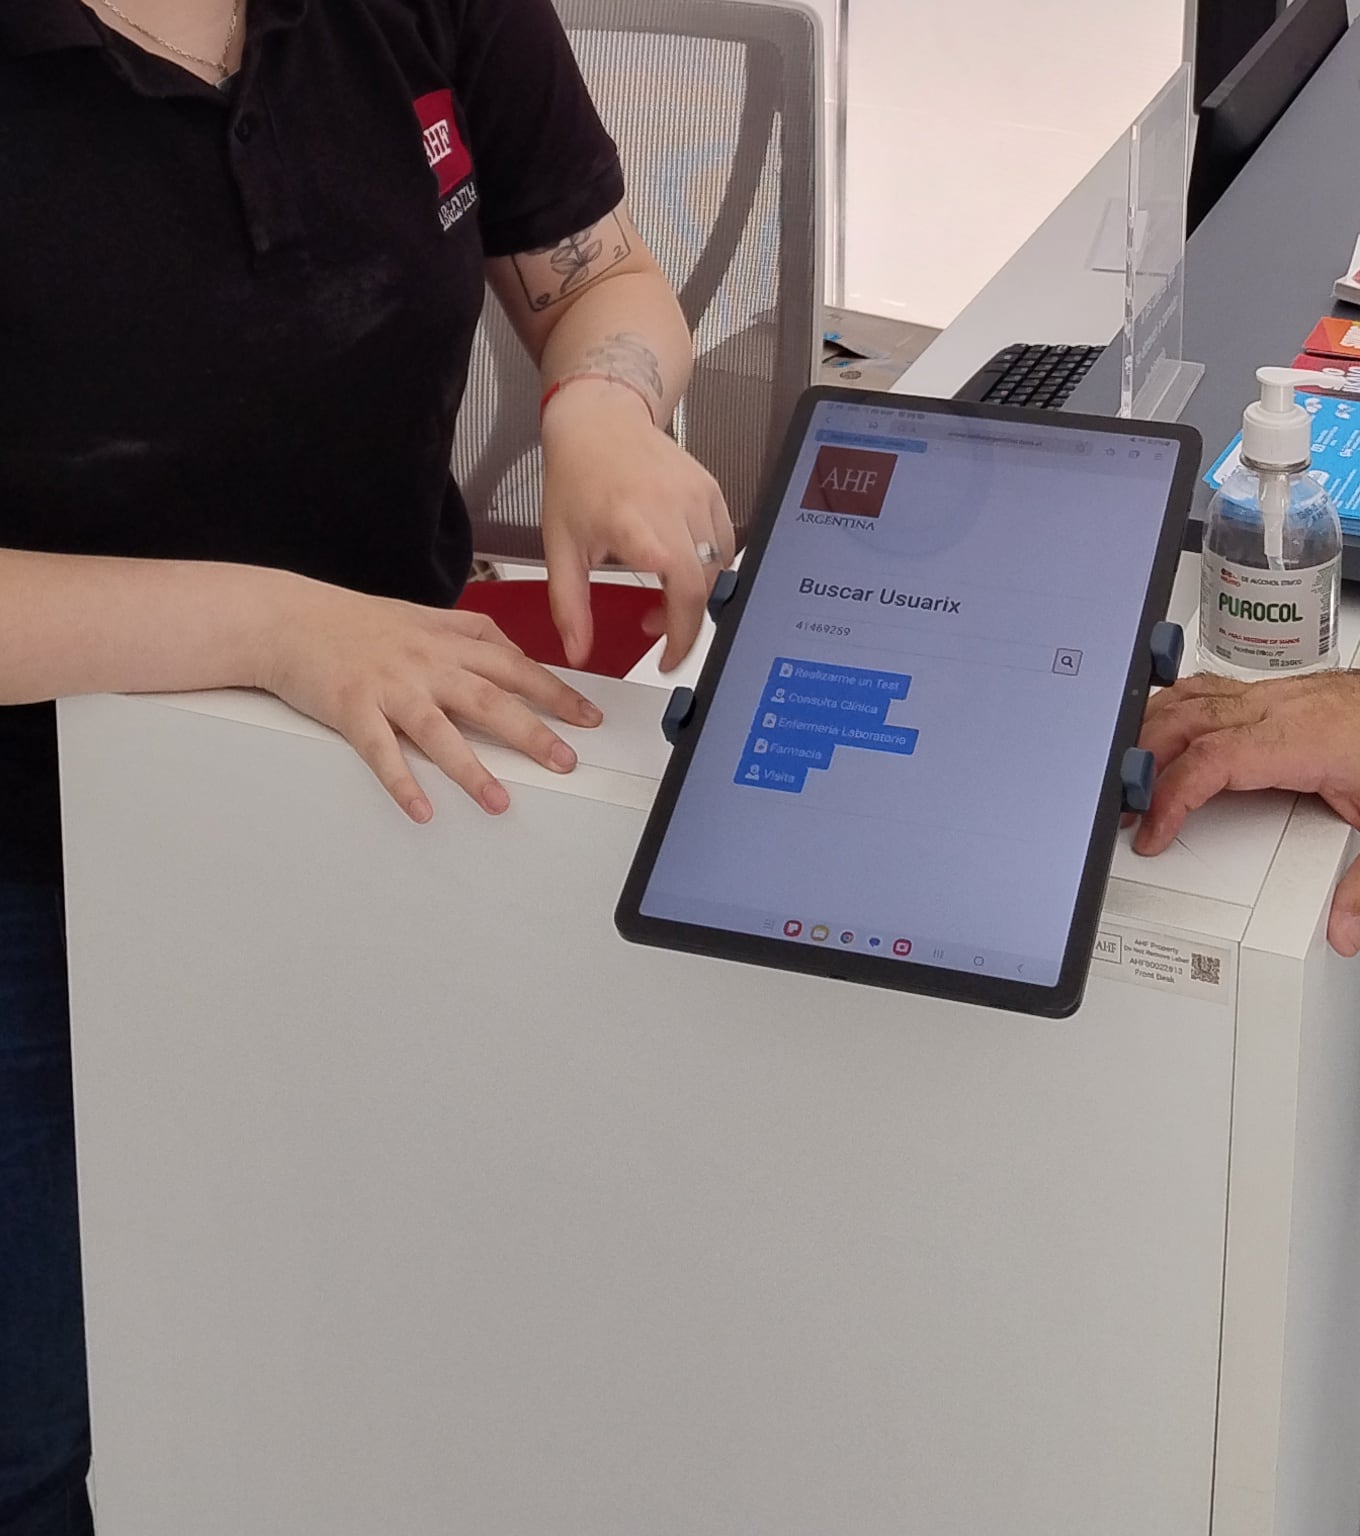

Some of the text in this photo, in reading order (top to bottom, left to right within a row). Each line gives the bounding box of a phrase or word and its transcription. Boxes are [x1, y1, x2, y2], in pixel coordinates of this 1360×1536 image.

[822, 466, 879, 495] AHF
[796, 512, 876, 531] ARGENTINA
[799, 577, 961, 614] Buscar Usuarix
[1219, 592, 1303, 623] PUROCOL
[794, 667, 900, 691] Realizarme un Test
[789, 693, 838, 709] Consulta
[764, 769, 795, 784] Visita
[1095, 940, 1117, 953] AHF
